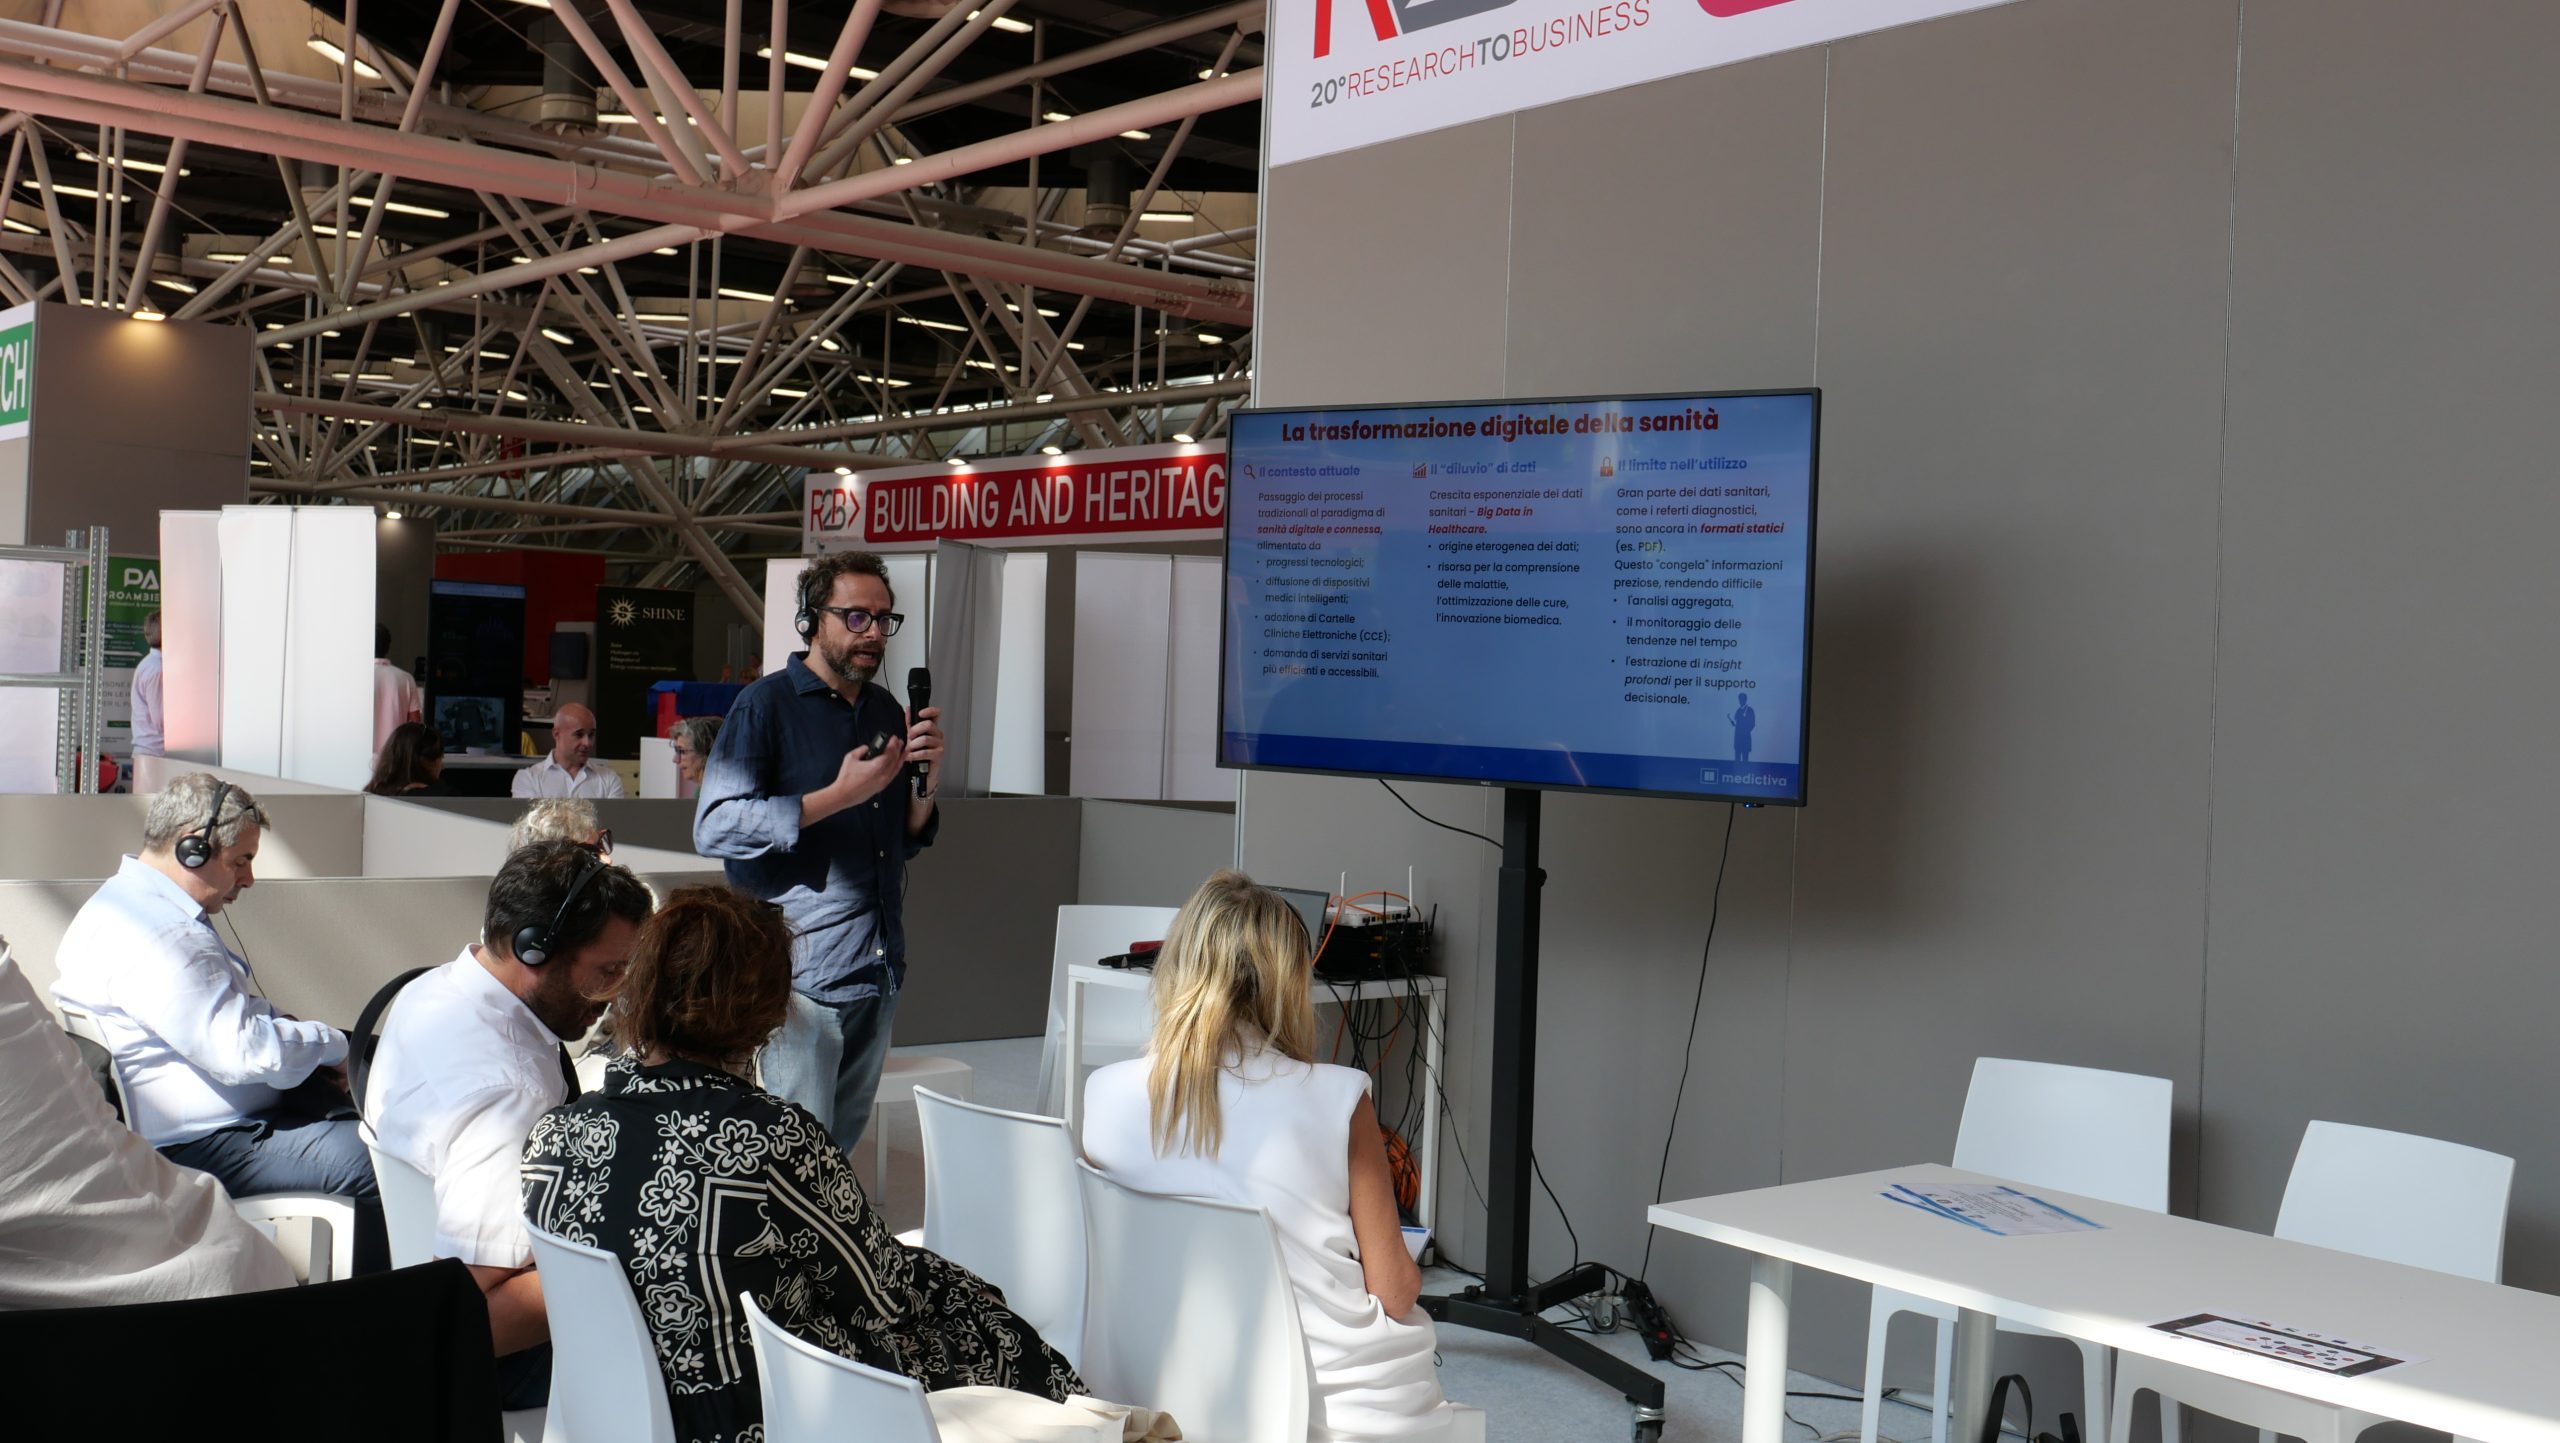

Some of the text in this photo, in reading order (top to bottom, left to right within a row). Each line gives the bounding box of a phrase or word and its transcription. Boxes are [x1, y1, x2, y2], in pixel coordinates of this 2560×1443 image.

[0, 340, 28, 412] CH
[1283, 408, 1719, 442] La trasformazione digitale della sanità
[1431, 464, 1437, 474] Il
[1497, 462, 1507, 473] di
[1512, 461, 1536, 473] dati
[1629, 459, 1666, 470] limite
[1260, 465, 1360, 477] Il contesto attuale
[873, 464, 1224, 533] BUILDING AND HERITAG
[1259, 491, 1363, 503] Passaggio dei processi
[1430, 489, 1582, 501] Crescita esponenziale dei dati
[1618, 486, 1770, 500] Gran parte dei dati sanitari,
[1259, 508, 1384, 519] tradizionali al paradigma di
[1429, 508, 1466, 516] sanitari
[1477, 508, 1493, 519] Big
[1496, 507, 1520, 516] Data
[1523, 506, 1532, 516] in
[1617, 507, 1647, 515] come
[1656, 505, 1688, 515] referti
[1692, 505, 1757, 518] diagnostici,
[1258, 525, 1286, 534] sanità
[1289, 525, 1324, 536] digitale
[1334, 526, 1383, 535] connessa,
[1429, 525, 1487, 533] Healthcare.
[1616, 523, 1784, 534] sono ancora in formati statici
[1258, 541, 1321, 550] alimentato da
[1439, 542, 1579, 553] origine eterogenea dei dati;
[1616, 540, 1666, 553] (es. PDF).
[1266, 557, 1364, 569] progressi tecnologici;
[1438, 562, 1579, 574] risorsa per la comprensione
[1615, 560, 1653, 570] Questo
[1712, 560, 1782, 570] informazioni
[1266, 576, 1369, 589] diffusione di dispositivi
[1438, 580, 1508, 590] delle malattie,
[1614, 578, 1763, 589] preziose, rendendo difficile
[106, 591, 160, 602] ROAMBIE
[1266, 594, 1348, 605] medici intelligenti;
[1516, 598, 1540, 607] delle
[1543, 600, 1568, 609] cure,
[1672, 597, 1734, 609] aggregata,
[642, 608, 685, 620] SHINE
[1264, 613, 1355, 623] adozione di Cartelle
[1504, 615, 1562, 625] biomedica.
[1627, 617, 1741, 631] il monitoraggio delle
[1264, 629, 1390, 642] Cliniche Elettroniche (CCE);
[1627, 636, 1737, 650] tendenze nel tempo
[1264, 649, 1387, 661] domanda di servizi sanitari
[1690, 658, 1700, 668] di
[1703, 659, 1741, 672] insight
[1263, 666, 1379, 677] più efficienti e accessibili.
[1625, 675, 1756, 690] profondi per il supporto
[1625, 693, 1690, 704] decisionale.
[1722, 774, 1786, 786] medictiva
